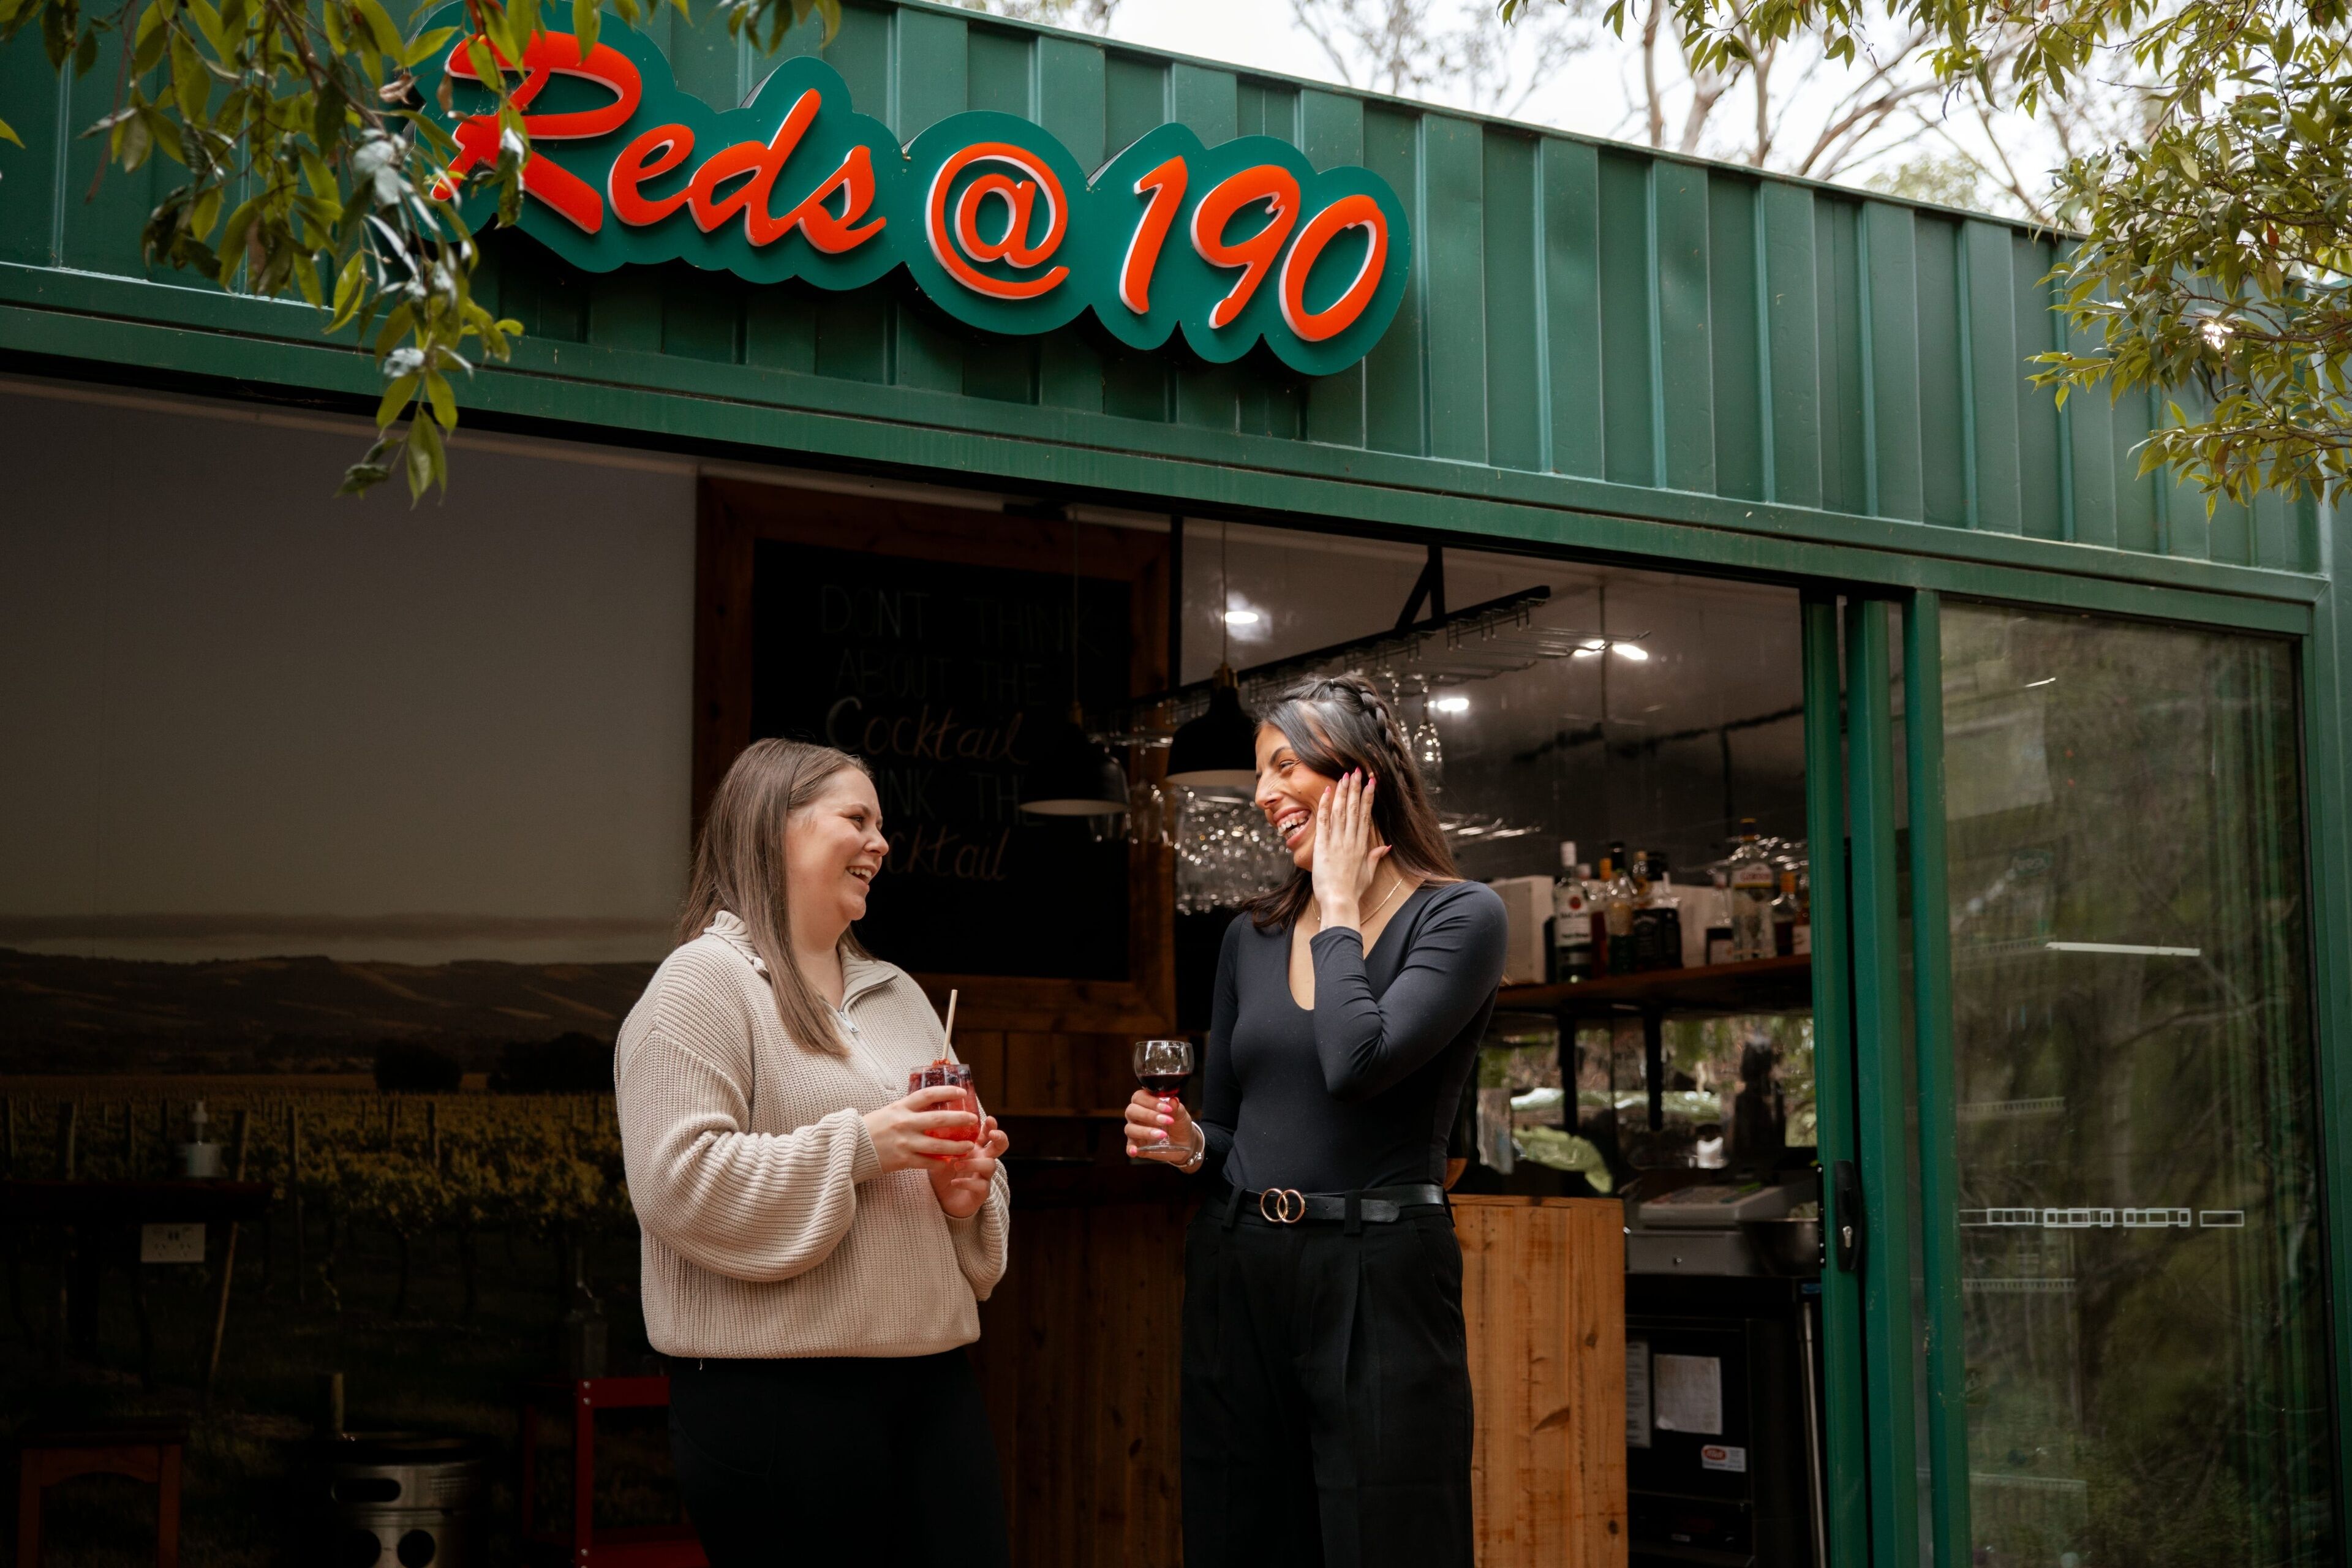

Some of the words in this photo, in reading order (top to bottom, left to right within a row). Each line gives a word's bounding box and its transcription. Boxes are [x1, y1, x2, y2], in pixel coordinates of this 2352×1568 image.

[431, 29, 887, 255] Reds
[925, 141, 1070, 300] @
[1120, 154, 1388, 342] 190
[964, 598, 1105, 656] THINK
[834, 648, 951, 701] ABOUT
[975, 659, 1047, 706] THE
[825, 696, 1030, 766] Cocktail
[886, 823, 1009, 882] cktail
